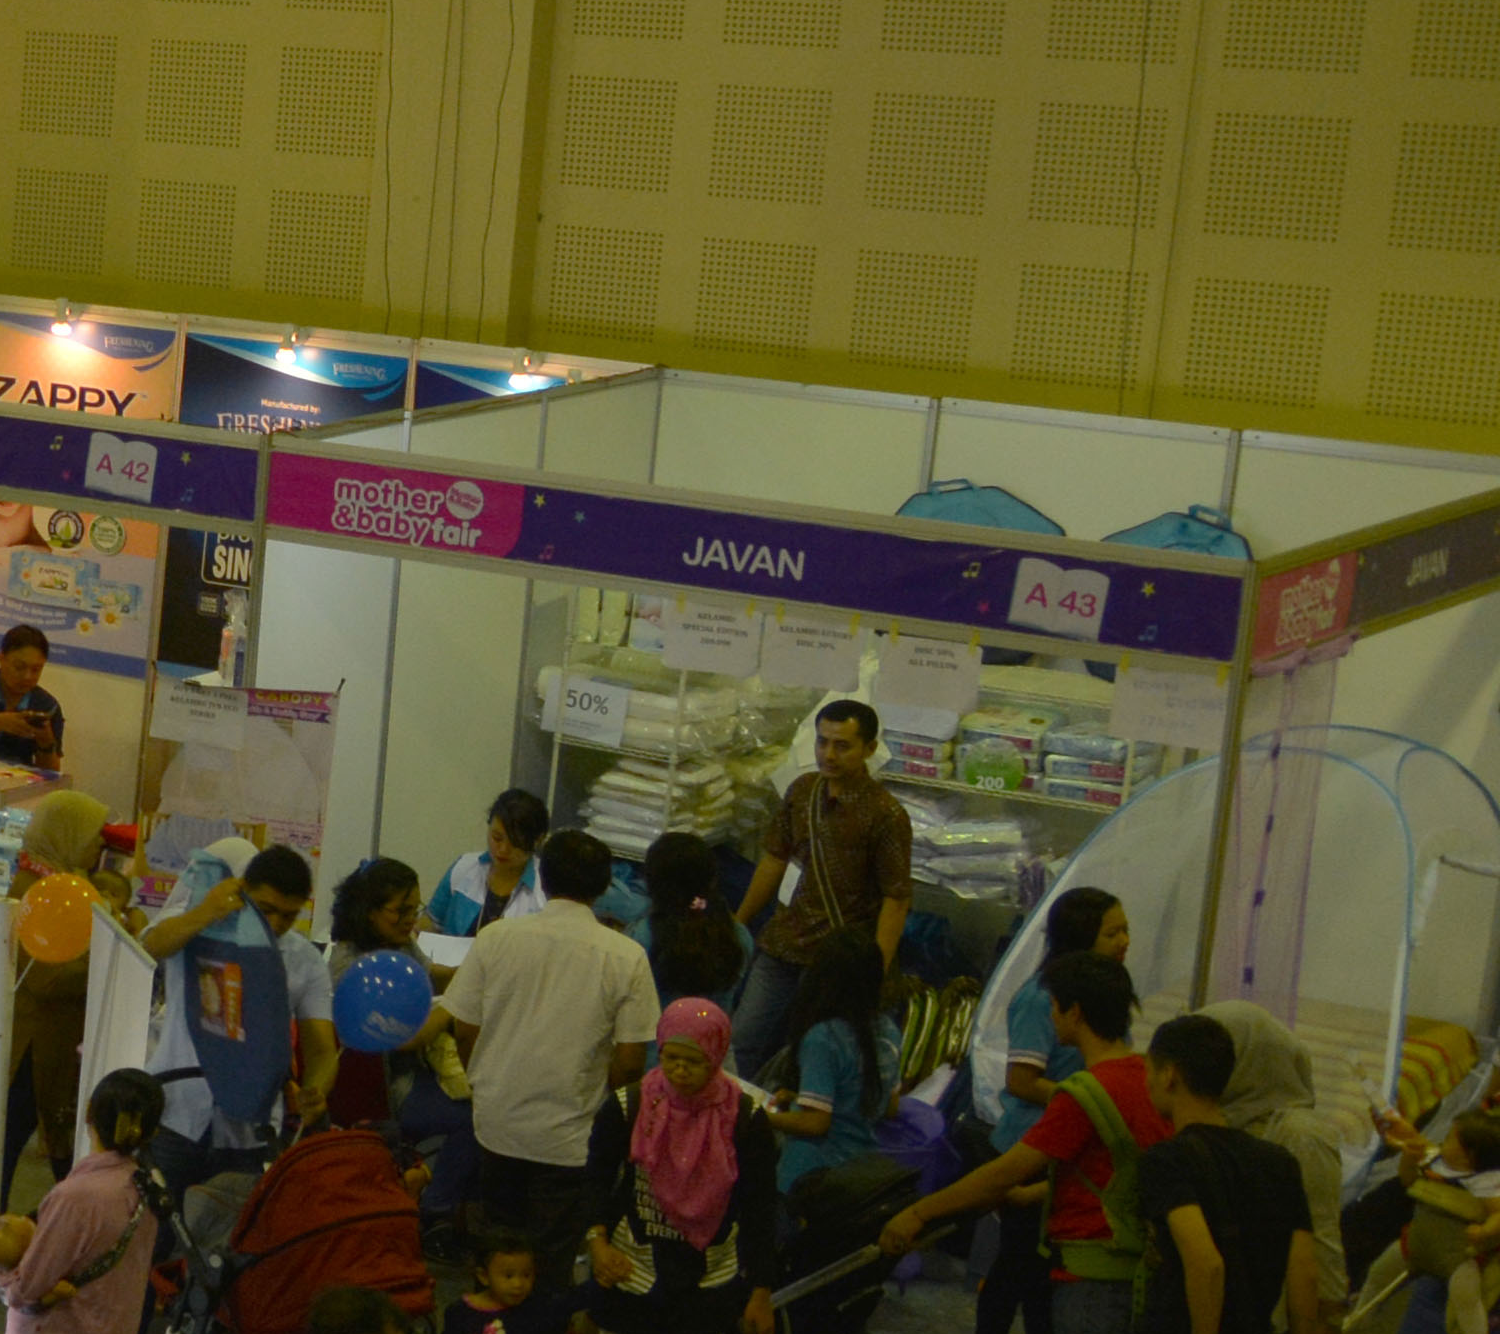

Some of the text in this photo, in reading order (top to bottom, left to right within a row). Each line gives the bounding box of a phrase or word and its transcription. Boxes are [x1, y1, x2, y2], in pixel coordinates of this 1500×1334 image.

[95, 453, 113, 476] A
[120, 461, 150, 484] 42
[333, 476, 444, 515] mother
[331, 501, 482, 549] &baby fair
[682, 535, 1098, 619] JAVAN A 43
[1406, 547, 1449, 588] JAVAN
[564, 687, 610, 718] 50%
[974, 774, 1006, 791] 200
